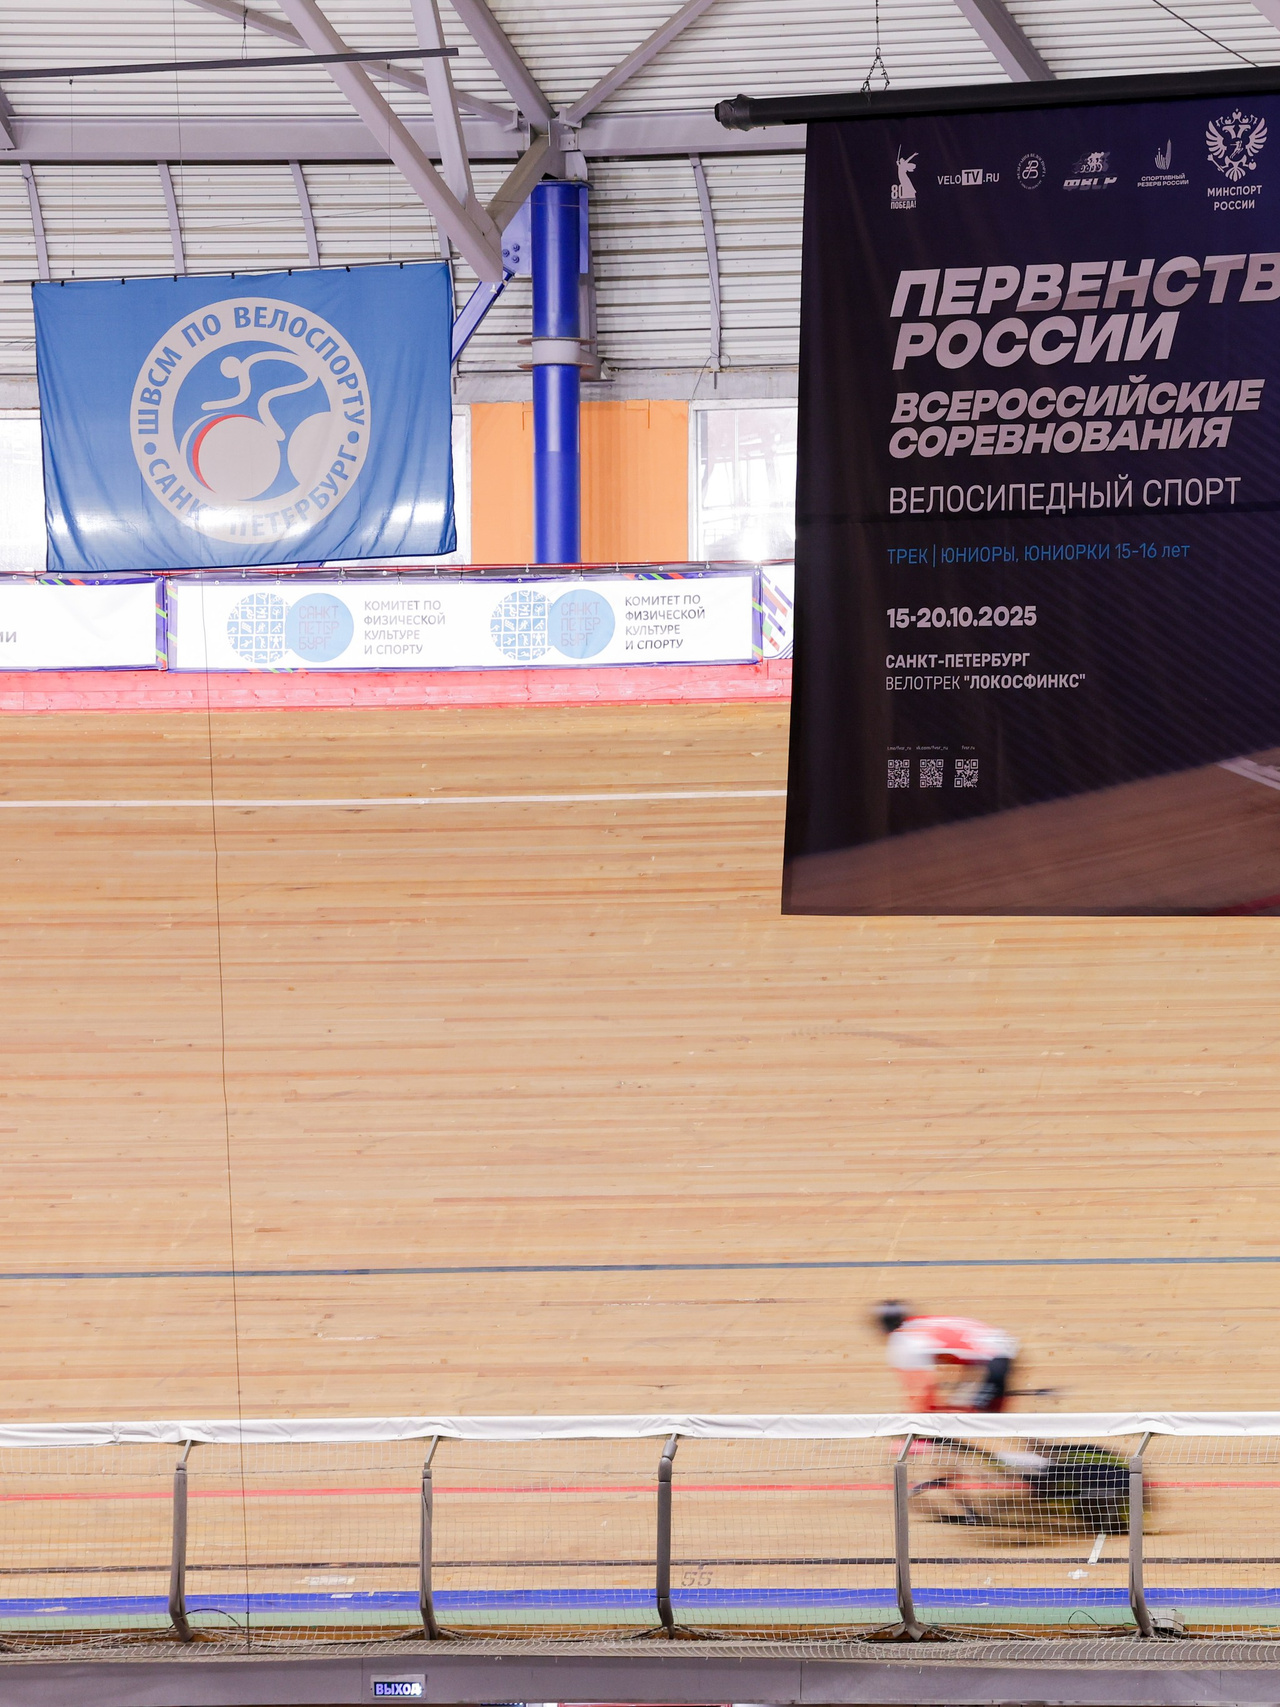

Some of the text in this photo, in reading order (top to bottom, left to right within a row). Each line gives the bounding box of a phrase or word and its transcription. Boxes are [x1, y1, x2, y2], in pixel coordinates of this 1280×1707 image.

[937, 169, 999, 186] VELOTV.RU
[1141, 173, 1186, 182] СПОРТИВНЫЙ
[1207, 184, 1262, 198] МИНСПОРТ
[890, 200, 917, 210] ПОБЕДА!
[1213, 199, 1255, 211] РОССИИ
[892, 311, 1180, 370] РОССИИ
[137, 306, 366, 435] ШВСМ ПО ВЕЛОСПОРТУ
[890, 374, 1266, 424] ВСЕРОССИЙСКИЕ
[888, 416, 1233, 459] СОРЕВНОВАНИЯ
[889, 473, 1241, 515] ВЕЛОСИПЕДНЫЙ СПОРТ
[887, 548, 929, 565] ТРЕК
[941, 546, 1020, 563] ЮНИОРЫ,
[1024, 544, 1110, 562] ЮНИОРКИ
[1115, 542, 1158, 559] 15-16
[1161, 545, 1190, 558] лет
[364, 600, 442, 611] КОМИТЕТ ПО
[625, 594, 700, 607] КОМИТЕТ ПО
[298, 605, 340, 620] САНКТ
[560, 602, 600, 616] САНКТ
[624, 606, 706, 620] ФИЗИЧЕСКОЙ
[364, 612, 446, 626] ФИЗИЧЕСКОЙ
[560, 616, 600, 632] ПЕТЕР
[886, 605, 1038, 629] 15-20.10.2025
[298, 620, 340, 635] ПЕТЕР
[625, 624, 680, 636] КУЛЬТУРЕ
[364, 630, 420, 641] КУЛЬТУРЕ
[560, 632, 594, 647] БУРГ
[298, 636, 332, 650] БУРГ
[364, 644, 424, 655] И СПОРТУ
[625, 639, 684, 650] И СПОРТУ
[885, 652, 1030, 669] САНКТ-ПЕТЕРБУРГ
[885, 674, 1086, 691] ВЕЛОТРЕК "ЛОКОСФИНКС"
[375, 1683, 421, 1695] ВЫХОД
